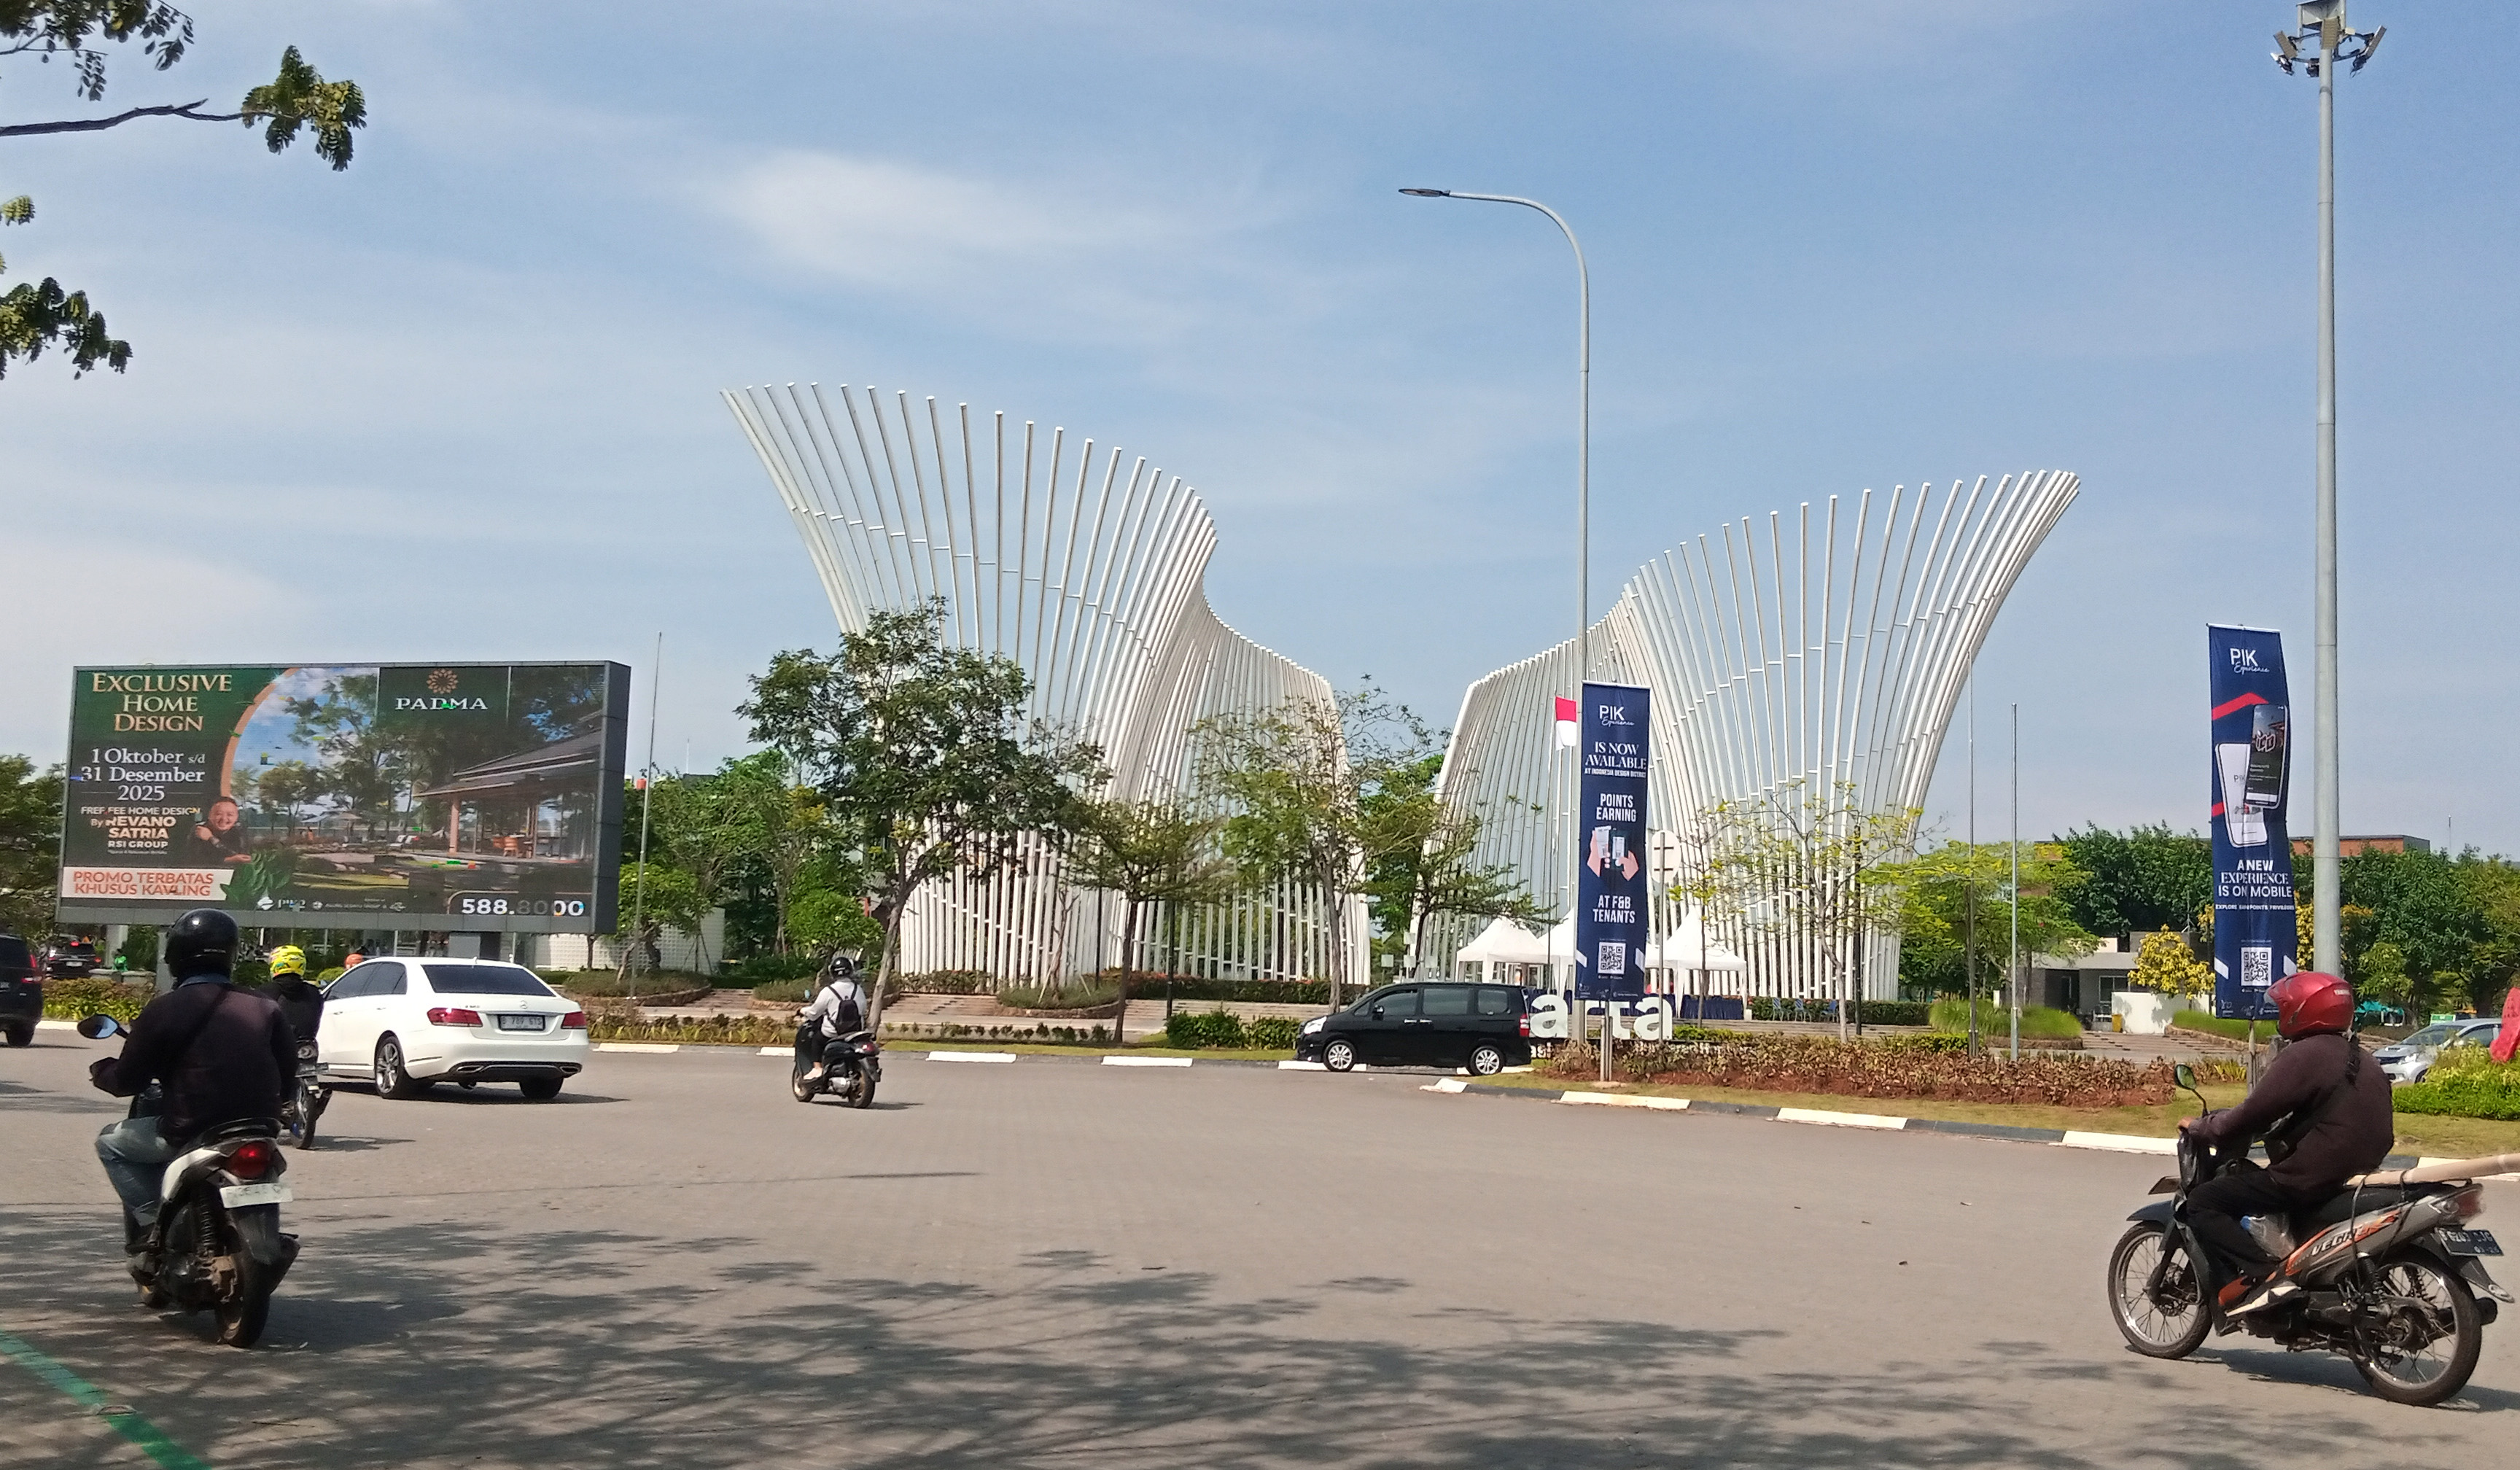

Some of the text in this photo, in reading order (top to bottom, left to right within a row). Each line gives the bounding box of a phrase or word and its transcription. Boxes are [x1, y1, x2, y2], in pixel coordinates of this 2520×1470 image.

[2230, 648, 2258, 666] PIK
[92, 672, 233, 692] EXCLUSIVE
[122, 694, 198, 712] HOME
[394, 697, 489, 709] PADMA
[1599, 705, 1625, 720] PIK
[114, 714, 204, 731] DESIGN
[1595, 741, 1639, 755] IS NOW
[92, 748, 206, 764] 1 Oktober s/d
[1584, 754, 1646, 770] AVAILABLE
[81, 766, 205, 782] 31 Desember
[117, 785, 166, 801] 2025
[1600, 793, 1633, 808] POINTS
[128, 807, 160, 815] HOME
[1595, 806, 1636, 822] EARNING
[90, 818, 104, 828] By
[108, 828, 169, 839] SATRIA
[108, 840, 168, 849] RSI GROUP
[2237, 860, 2274, 871] A NEW
[73, 871, 214, 884] PROMO TERBATAS
[2221, 872, 2289, 884] EXPERIENCE
[74, 883, 211, 896] KHUSUS KAVLING
[2218, 885, 2292, 898] IS ON MOBILE
[1598, 895, 1631, 909] AT F&B
[1592, 909, 1636, 924] TENANTS
